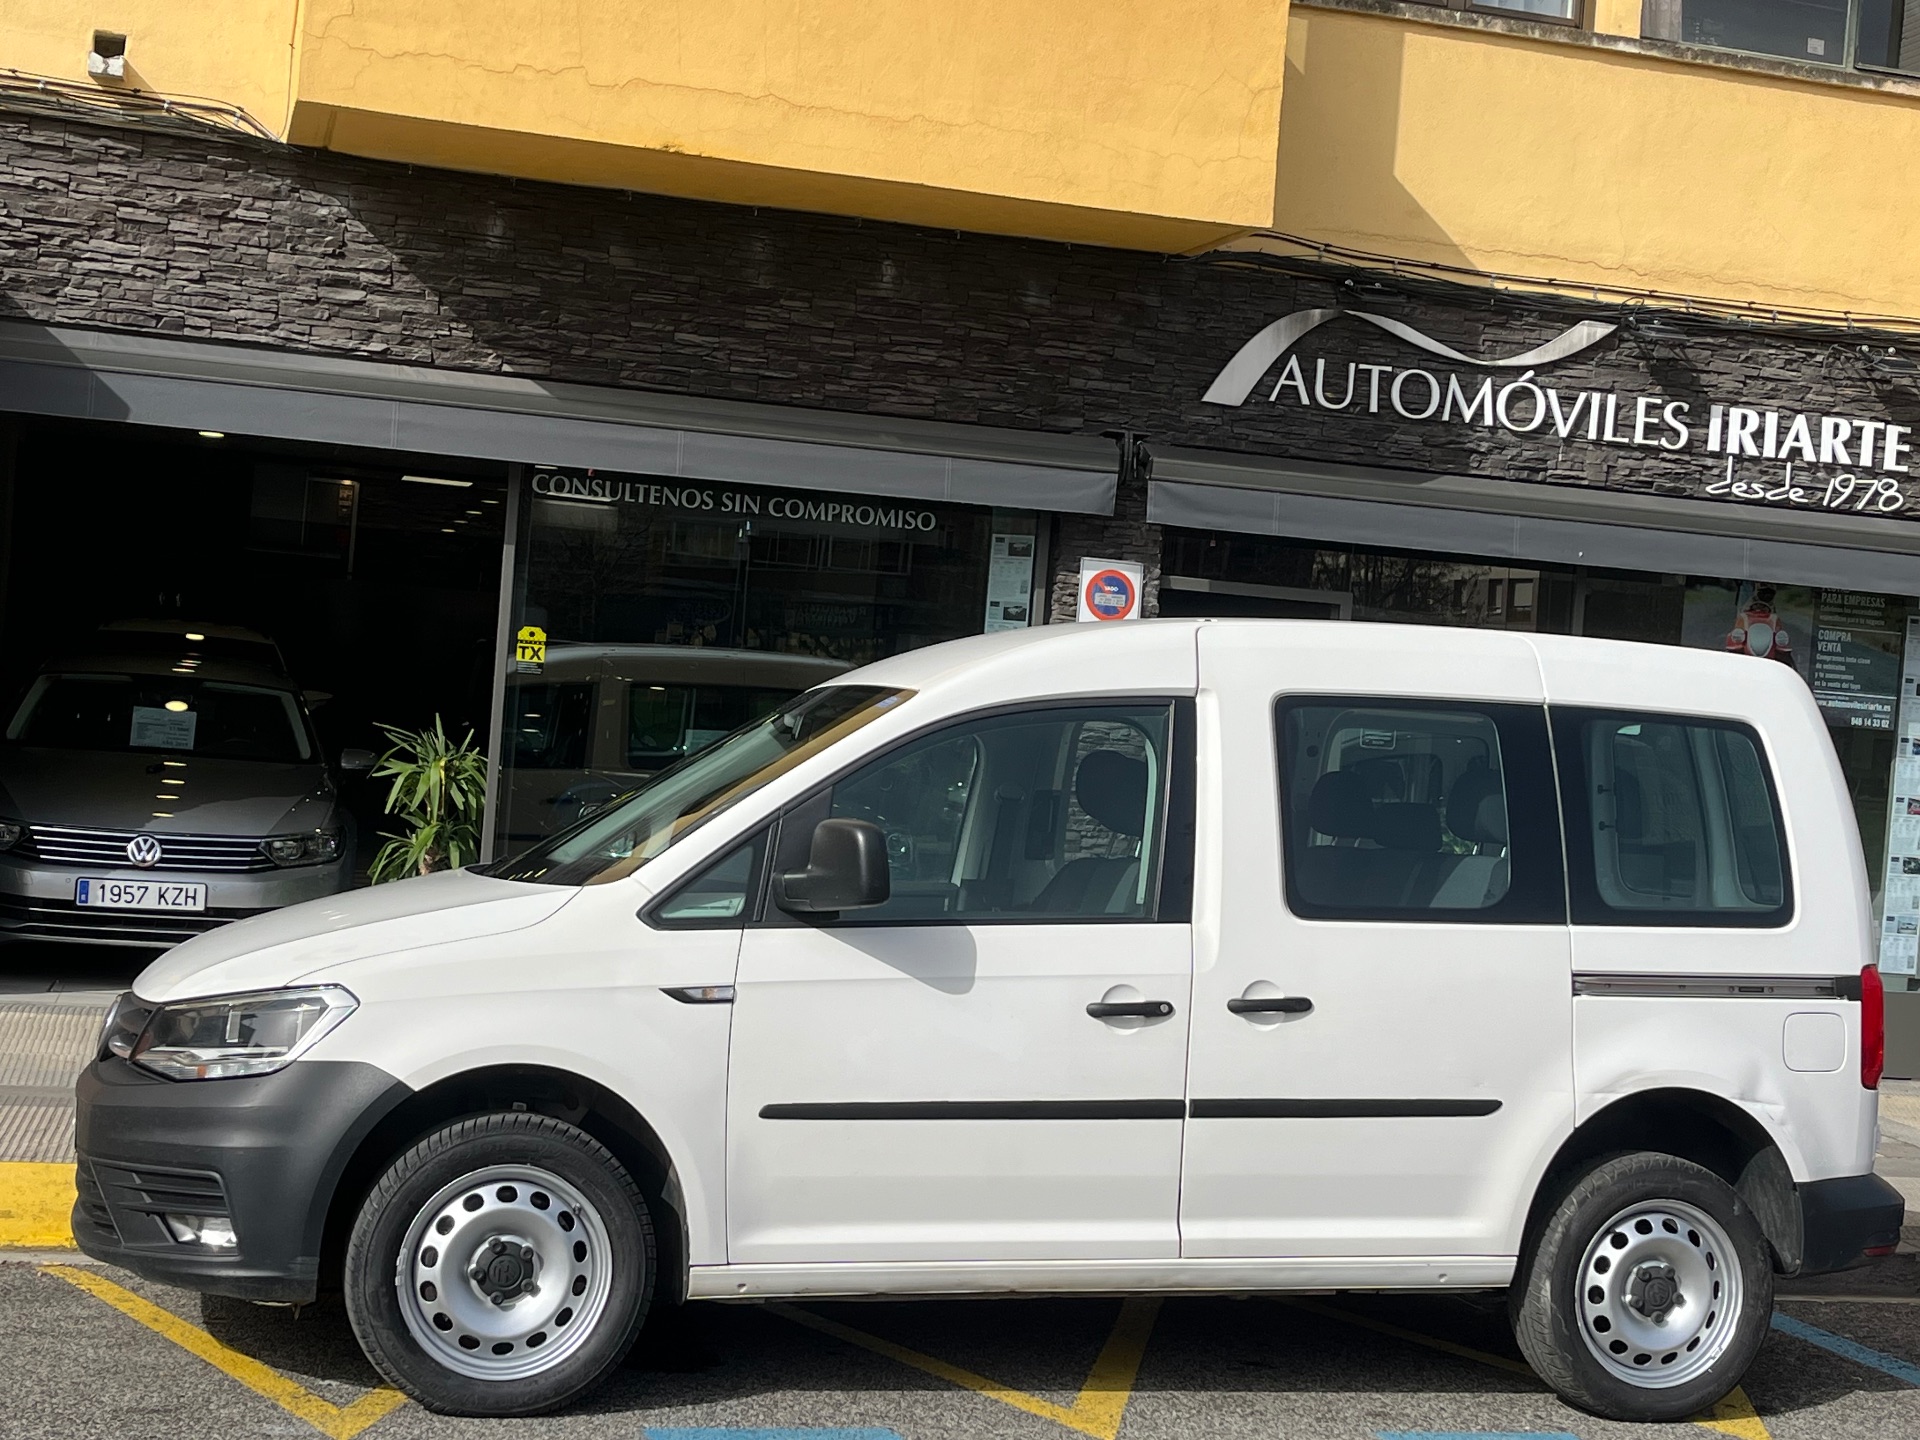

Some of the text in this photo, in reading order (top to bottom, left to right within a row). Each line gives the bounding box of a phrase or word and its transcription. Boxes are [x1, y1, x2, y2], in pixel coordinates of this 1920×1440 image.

[1268, 353, 1912, 472] AUTOMÓVILES IRIARTE
[1705, 456, 1905, 512] desde 1978
[531, 473, 937, 532] CONSULTENOS SIN COMPROMISO
[1821, 593, 1885, 608] PARA EMPRESAS
[1818, 629, 1852, 642] COMPRA
[518, 646, 542, 661] TX
[1817, 641, 1842, 653] VENTA
[1864, 717, 1872, 726] 14
[1872, 718, 1880, 727] 33
[1881, 719, 1890, 728] 02
[99, 883, 198, 907] 1957 KZH
